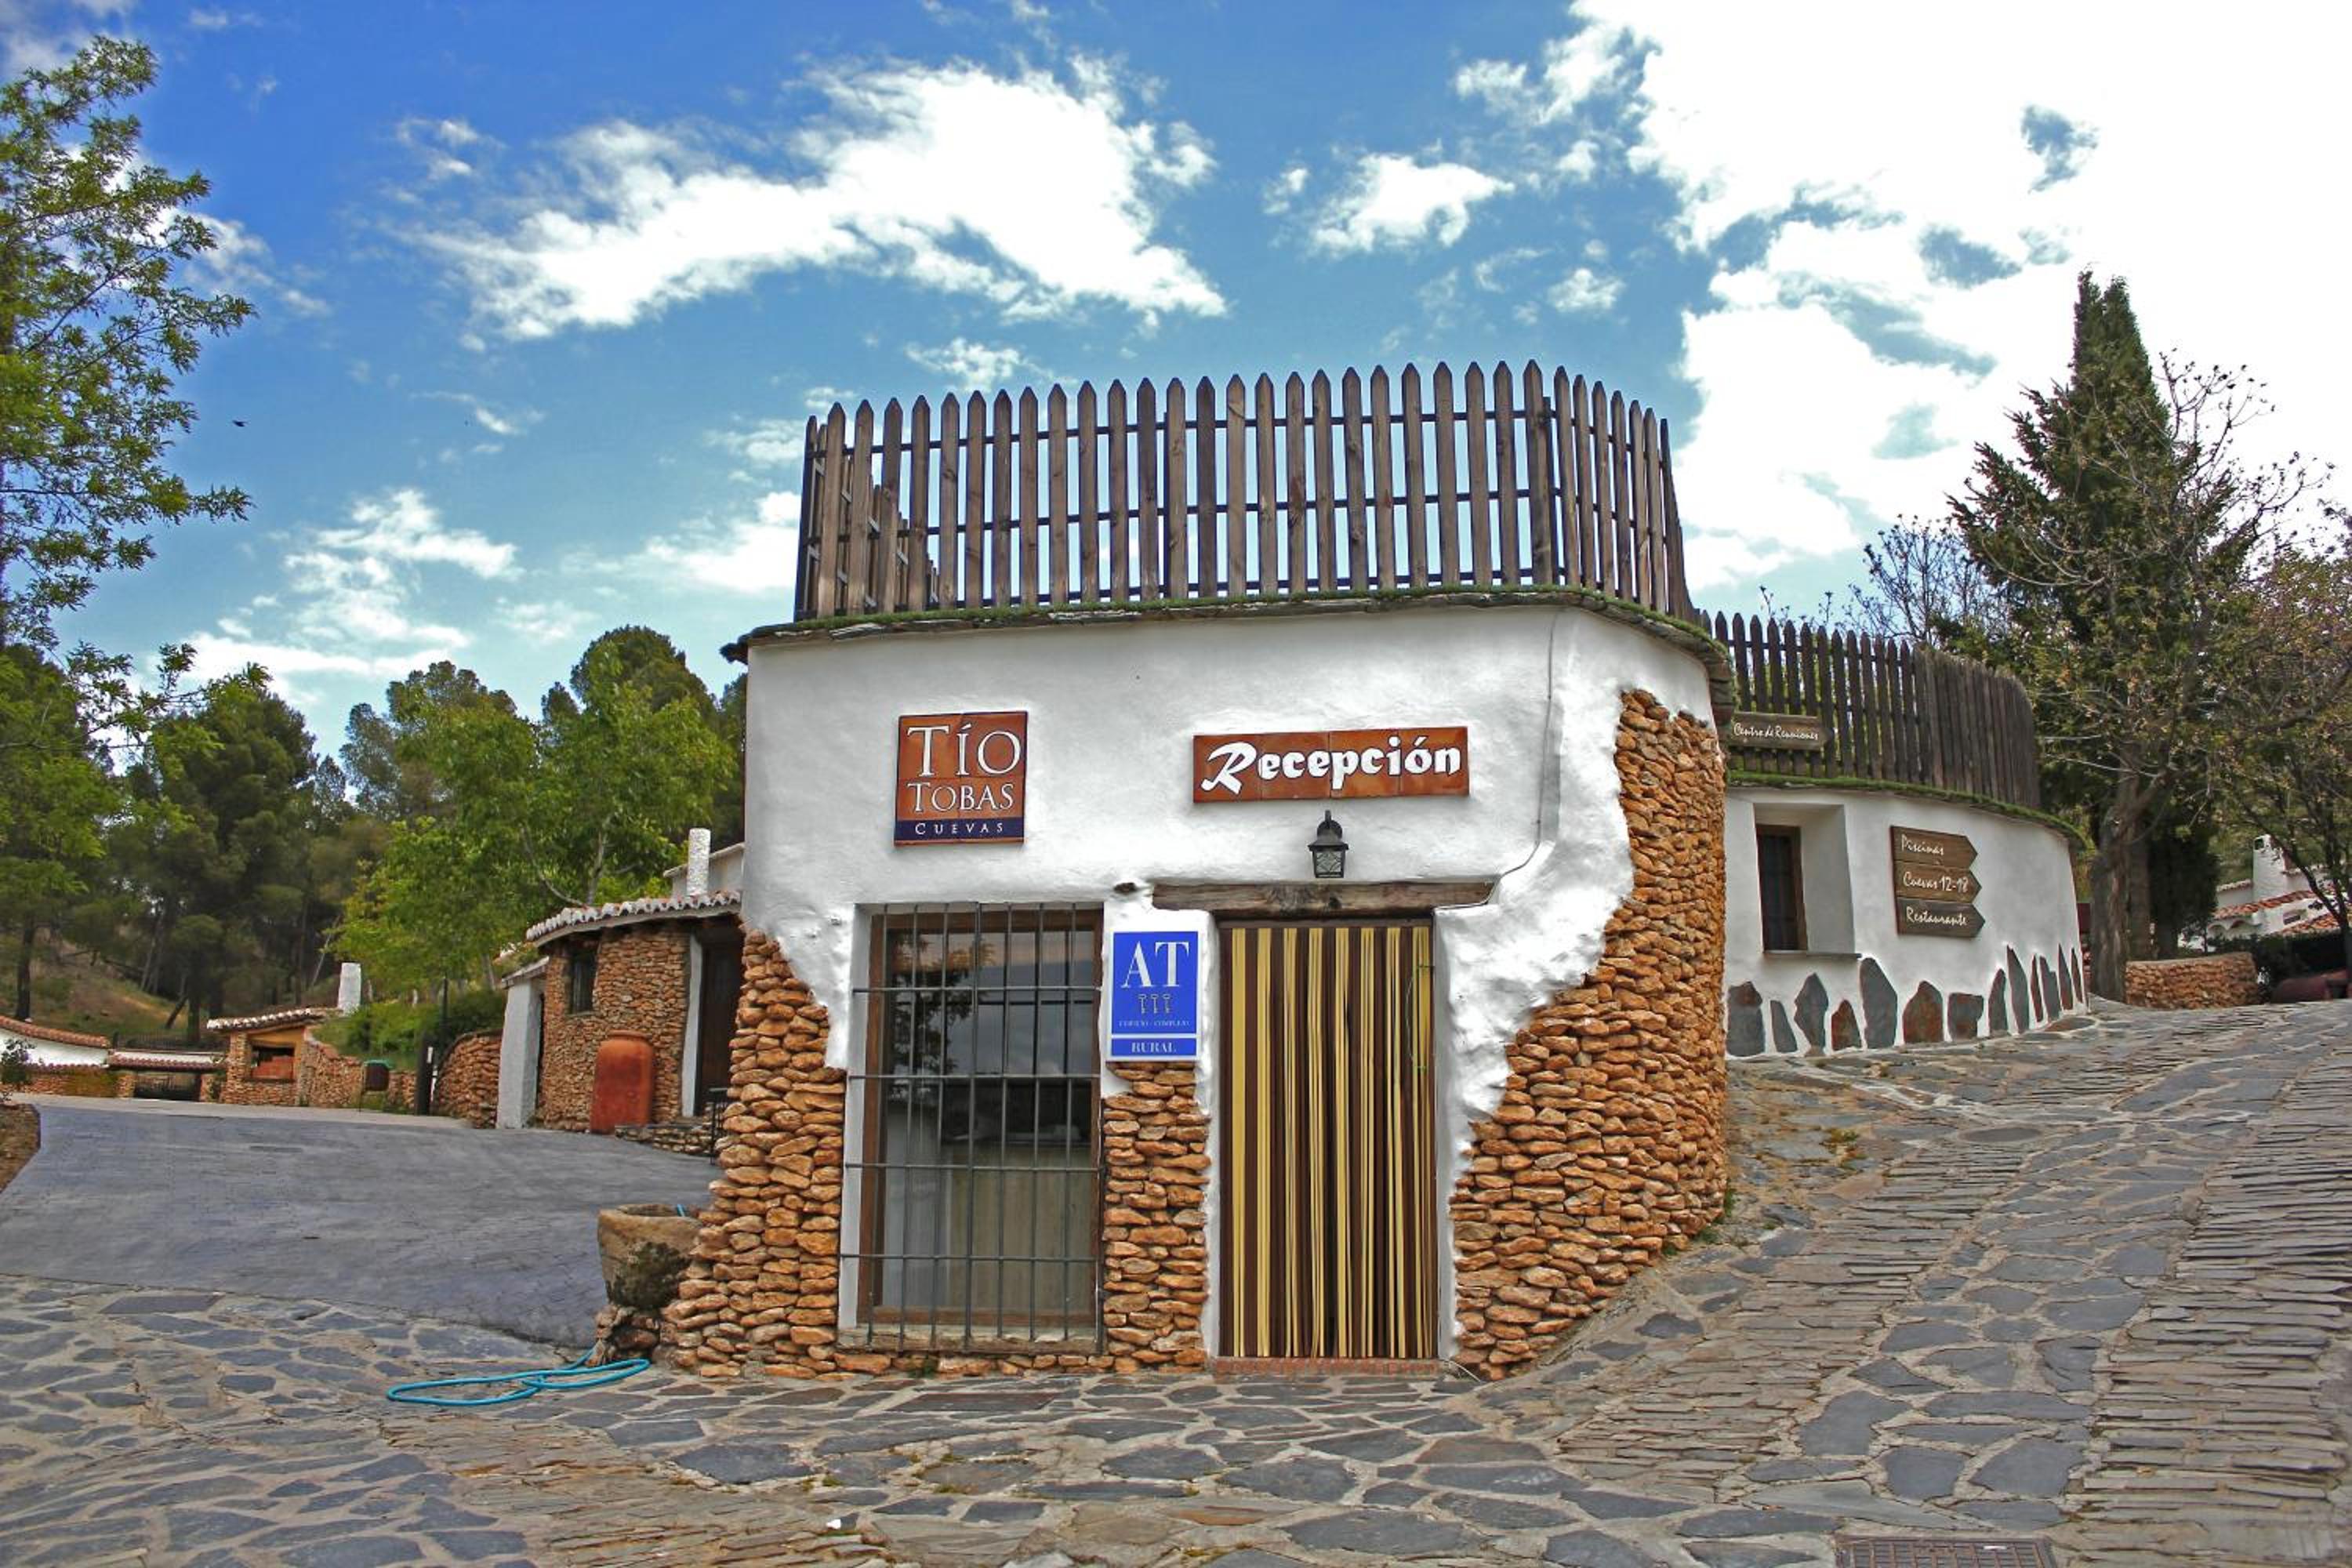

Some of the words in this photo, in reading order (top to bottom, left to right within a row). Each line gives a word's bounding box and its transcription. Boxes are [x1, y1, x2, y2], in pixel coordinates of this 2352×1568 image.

[907, 723, 1021, 777] TÍO
[1200, 735, 1461, 795] Recepción
[907, 782, 1014, 812] TOBAS
[915, 822, 1004, 835] CUEVAS
[1901, 833, 1944, 856] Piscinas
[1906, 906, 1968, 926] Restaurante
[1121, 941, 1189, 988] AT
[1131, 1042, 1177, 1054] RURAL
